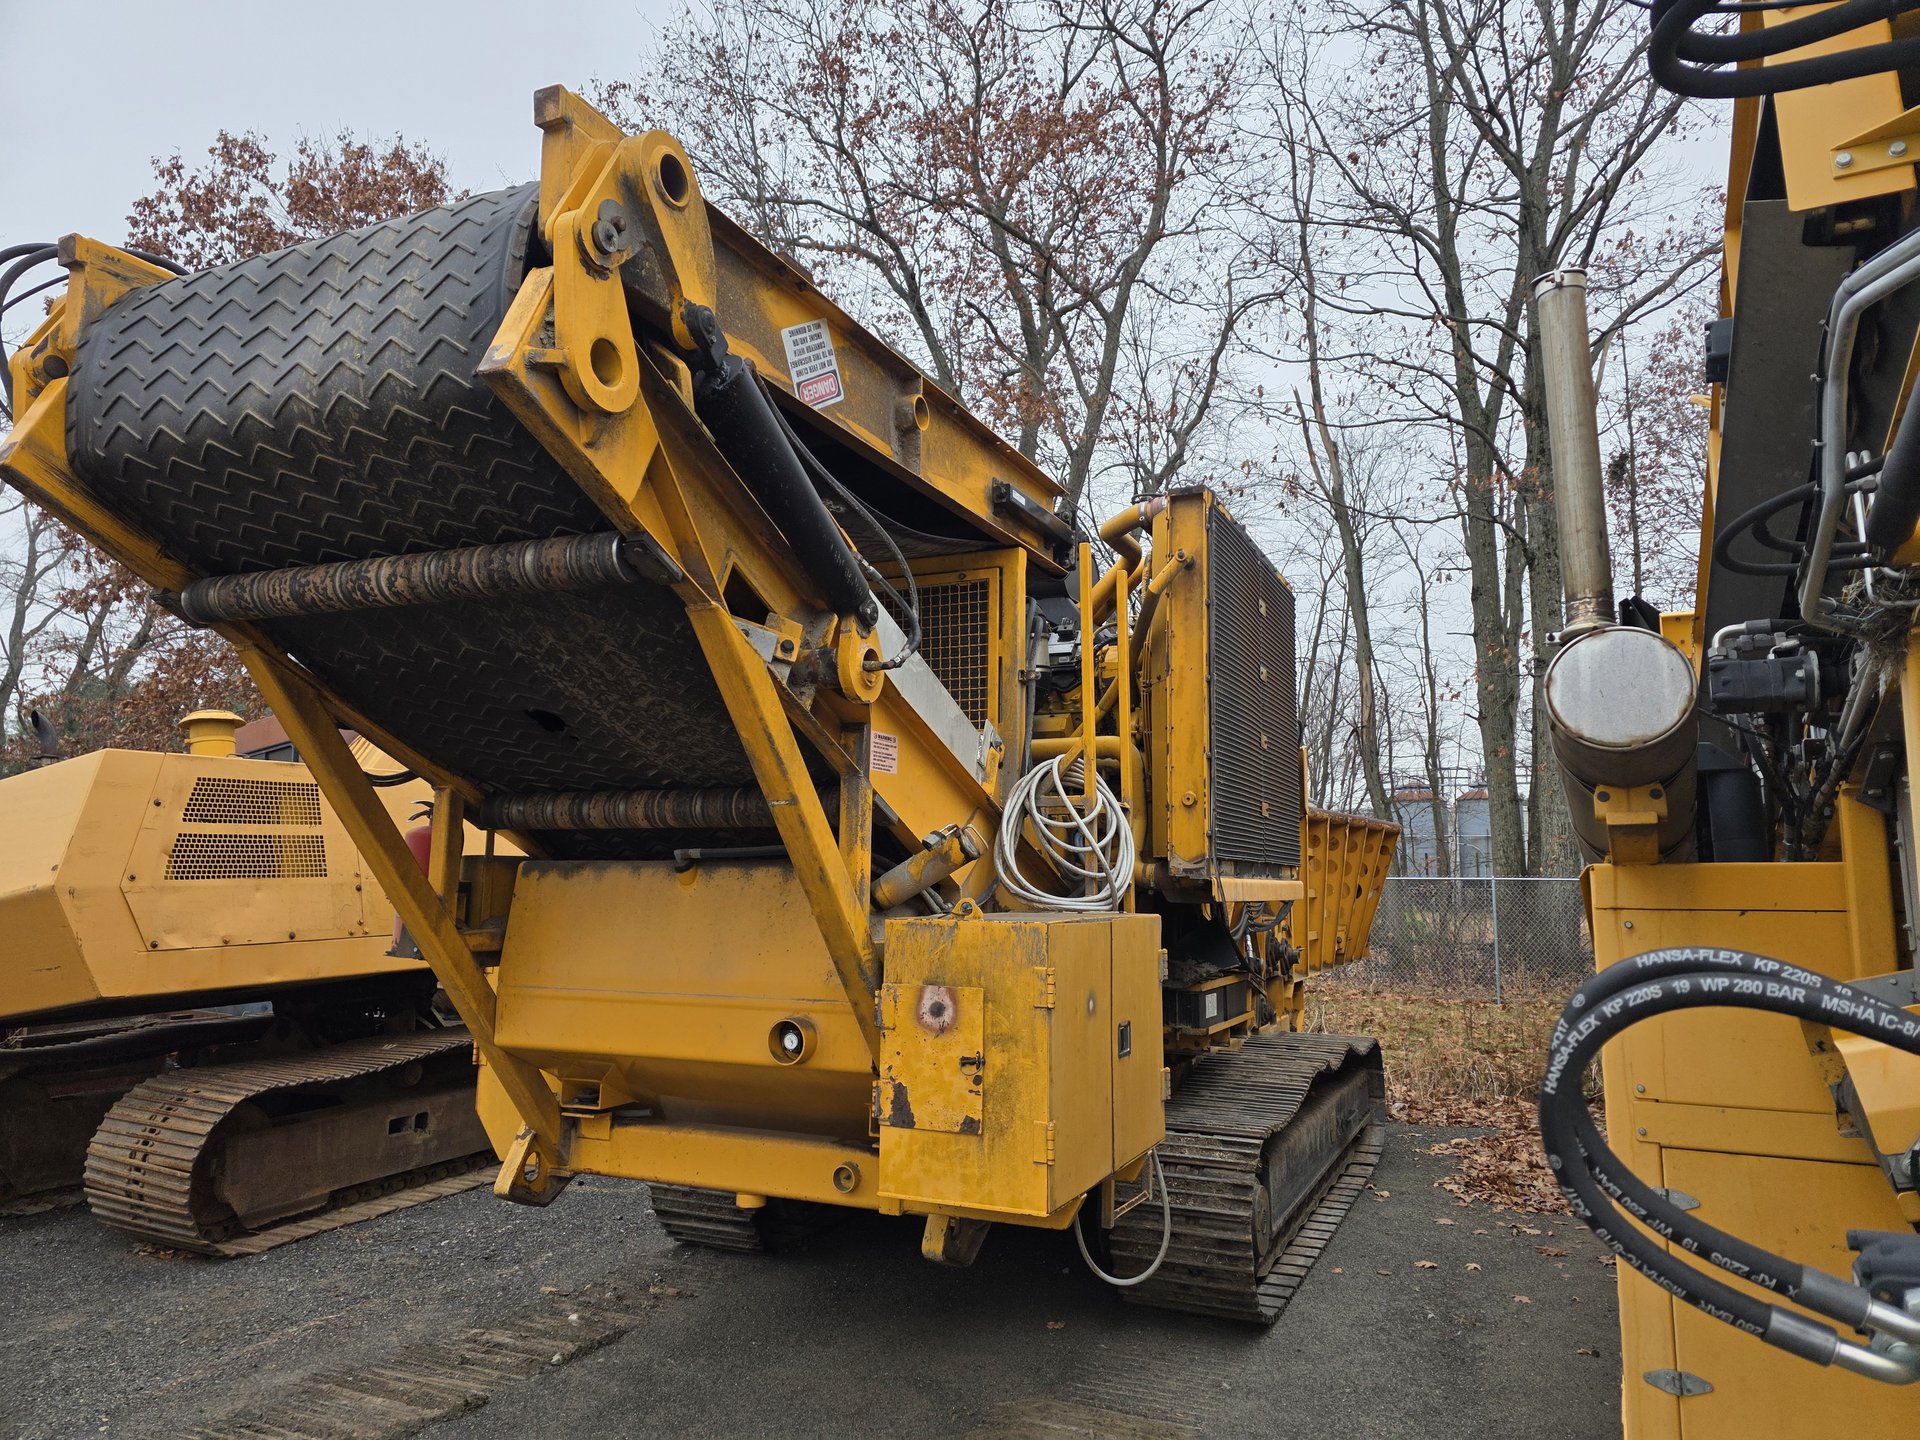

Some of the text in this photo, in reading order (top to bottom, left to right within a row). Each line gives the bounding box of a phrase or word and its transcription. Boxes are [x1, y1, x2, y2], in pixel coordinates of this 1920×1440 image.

[789, 326, 807, 337] RUNNING
[809, 332, 822, 342] ENGINE
[812, 352, 822, 361] THIS
[804, 379, 835, 401] DANGER
[1636, 950, 1744, 968] HANSA-FLEX
[1754, 958, 1780, 973] KP
[1781, 966, 1822, 988] 220S
[1544, 1014, 1602, 1095] HANSA-FLEX
[1602, 998, 1624, 1018] KP
[1626, 985, 1662, 1008] 220S
[1672, 980, 1690, 994] 19
[1700, 978, 1730, 991] WP
[1733, 979, 1763, 995] 280
[1766, 982, 1806, 1003] BAR
[1820, 994, 1875, 1024] MSHA
[1594, 1166, 1777, 1289] KP 220S 19 WP 280 BAR
[1596, 1228, 1640, 1268] IC-8/19
[1642, 1264, 1687, 1298] MSHA
[1699, 1300, 1734, 1323] BAR
